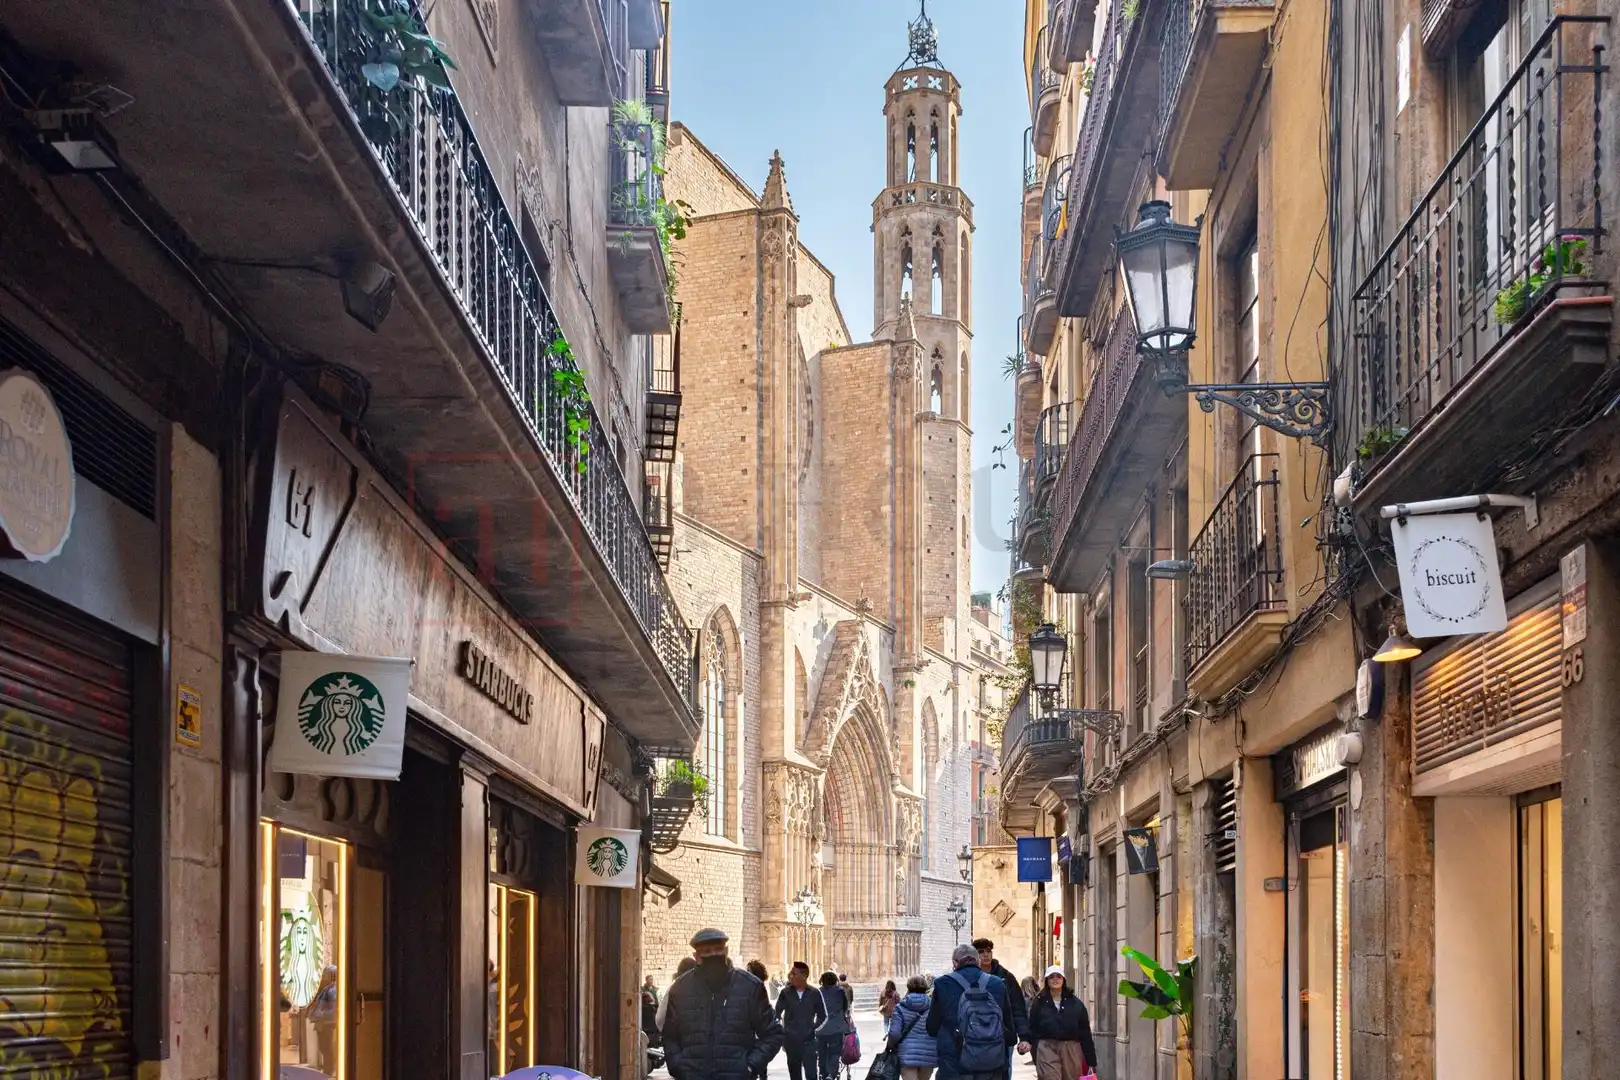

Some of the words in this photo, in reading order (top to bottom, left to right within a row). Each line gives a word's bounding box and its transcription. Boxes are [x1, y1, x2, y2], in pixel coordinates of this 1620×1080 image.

[1425, 567, 1476, 587] biscuit
[462, 641, 534, 725] STARBUCKS
[1562, 647, 1584, 688] 66
